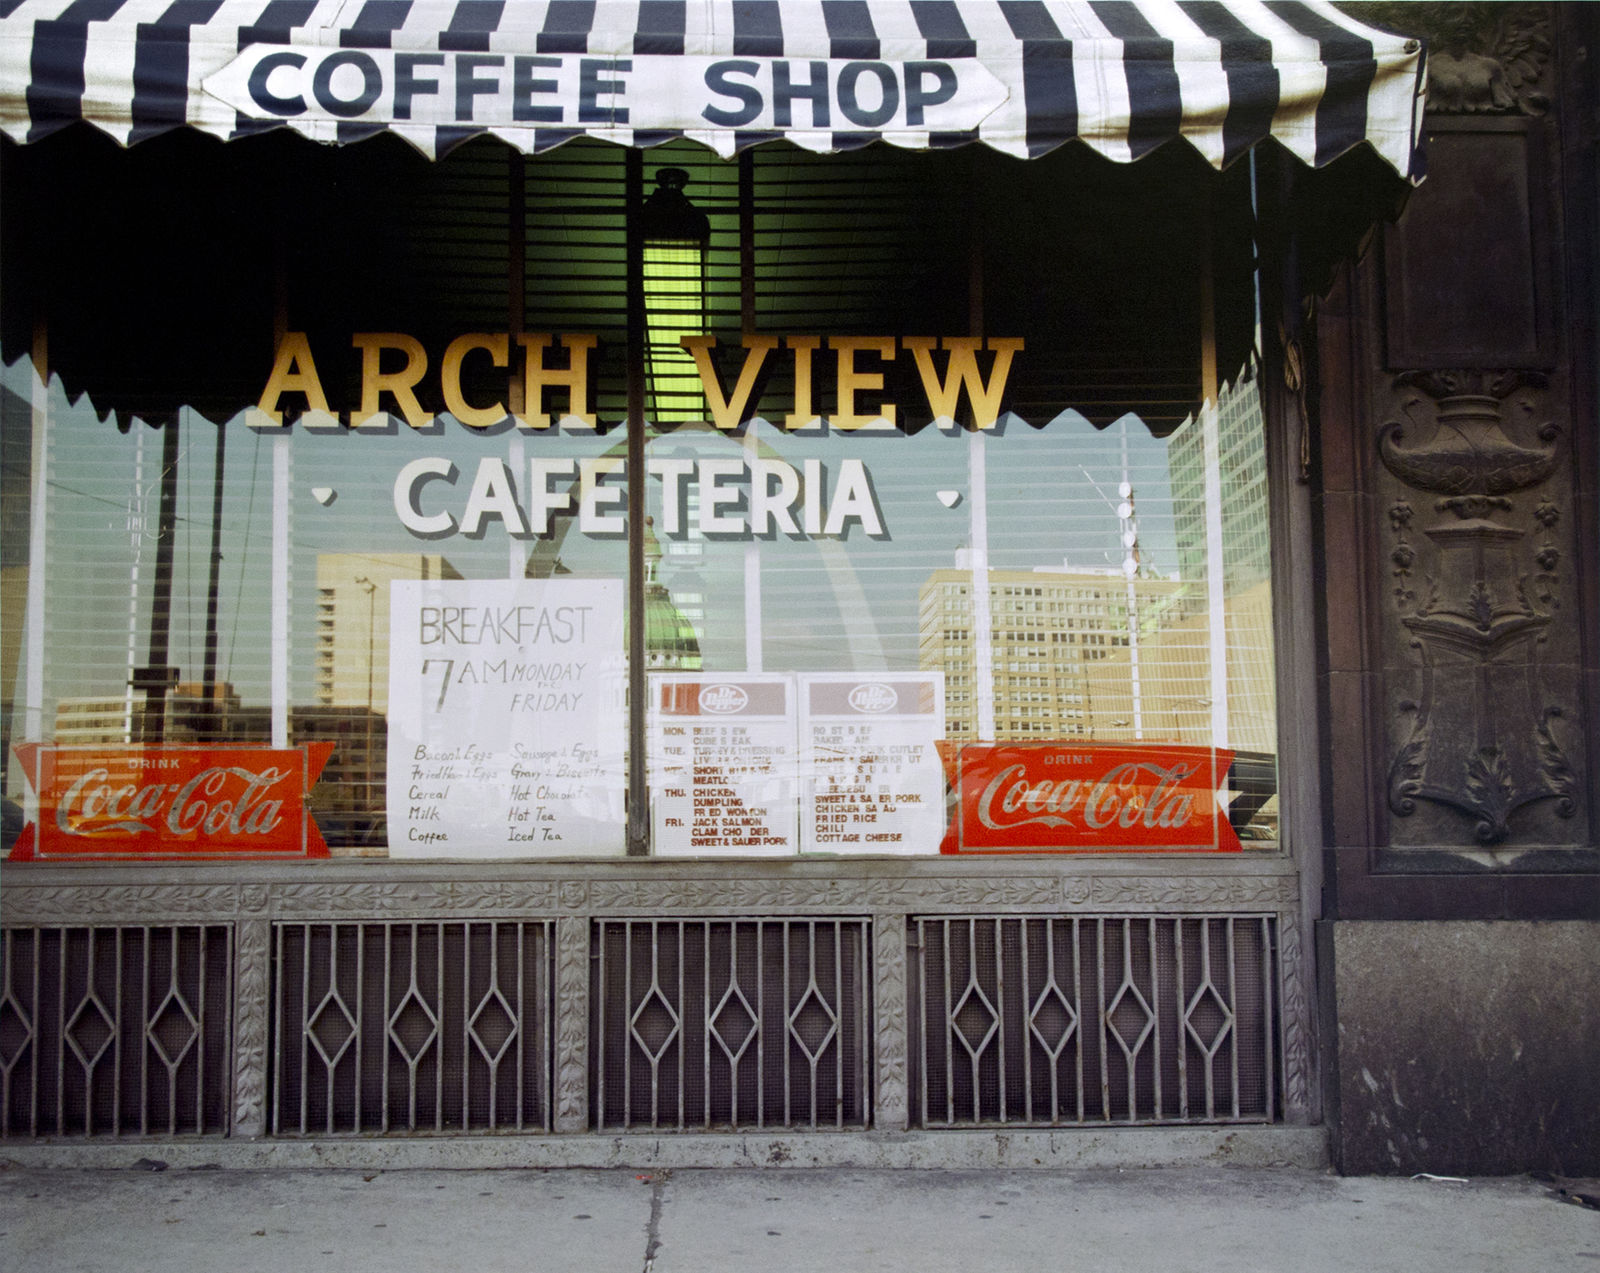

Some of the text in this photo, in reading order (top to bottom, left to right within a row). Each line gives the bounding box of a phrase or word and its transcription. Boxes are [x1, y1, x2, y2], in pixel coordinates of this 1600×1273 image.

[247, 49, 958, 128] COFFEE SHOP
[245, 332, 1025, 431] ARCH VIEW
[394, 457, 888, 539] CAFETERIA
[420, 606, 593, 645] BREAKFAST
[421, 659, 588, 713] 7 AM MONDAY
[718, 686, 733, 696] Dr
[869, 686, 885, 696] Dr
[510, 693, 583, 712] FRIDAY
[663, 727, 686, 736] MON.
[693, 727, 716, 736] BEEF
[693, 736, 717, 745] CUBE
[889, 745, 924, 754] CUTLET
[128, 758, 180, 769] DRINK
[1044, 754, 1093, 765] DRINK
[693, 766, 724, 775] SHORT
[408, 784, 450, 800] Cereal
[508, 784, 534, 801] Hot
[664, 788, 736, 798] THU. CHICKEN
[978, 762, 1202, 830] Coca-Cola
[56, 766, 292, 836] Coca-Cola
[693, 798, 743, 807] DUMPLING
[815, 794, 846, 803] SWEET
[849, 794, 856, 803] &
[895, 794, 921, 803] PORK
[408, 805, 441, 822] Milk
[815, 804, 859, 813] CHICKEN
[507, 806, 557, 822] Hot Tea
[815, 814, 877, 823] FRIED RICE
[665, 817, 762, 827] FRI. JACK SALMON
[691, 827, 718, 837] CLAM
[815, 824, 844, 833] CHILI
[408, 826, 449, 845] Coffee
[507, 826, 563, 842] Iced Tea
[815, 833, 903, 842] COTTAGE CHEESE
[690, 837, 722, 846] SWEET
[763, 837, 788, 846] PORK
